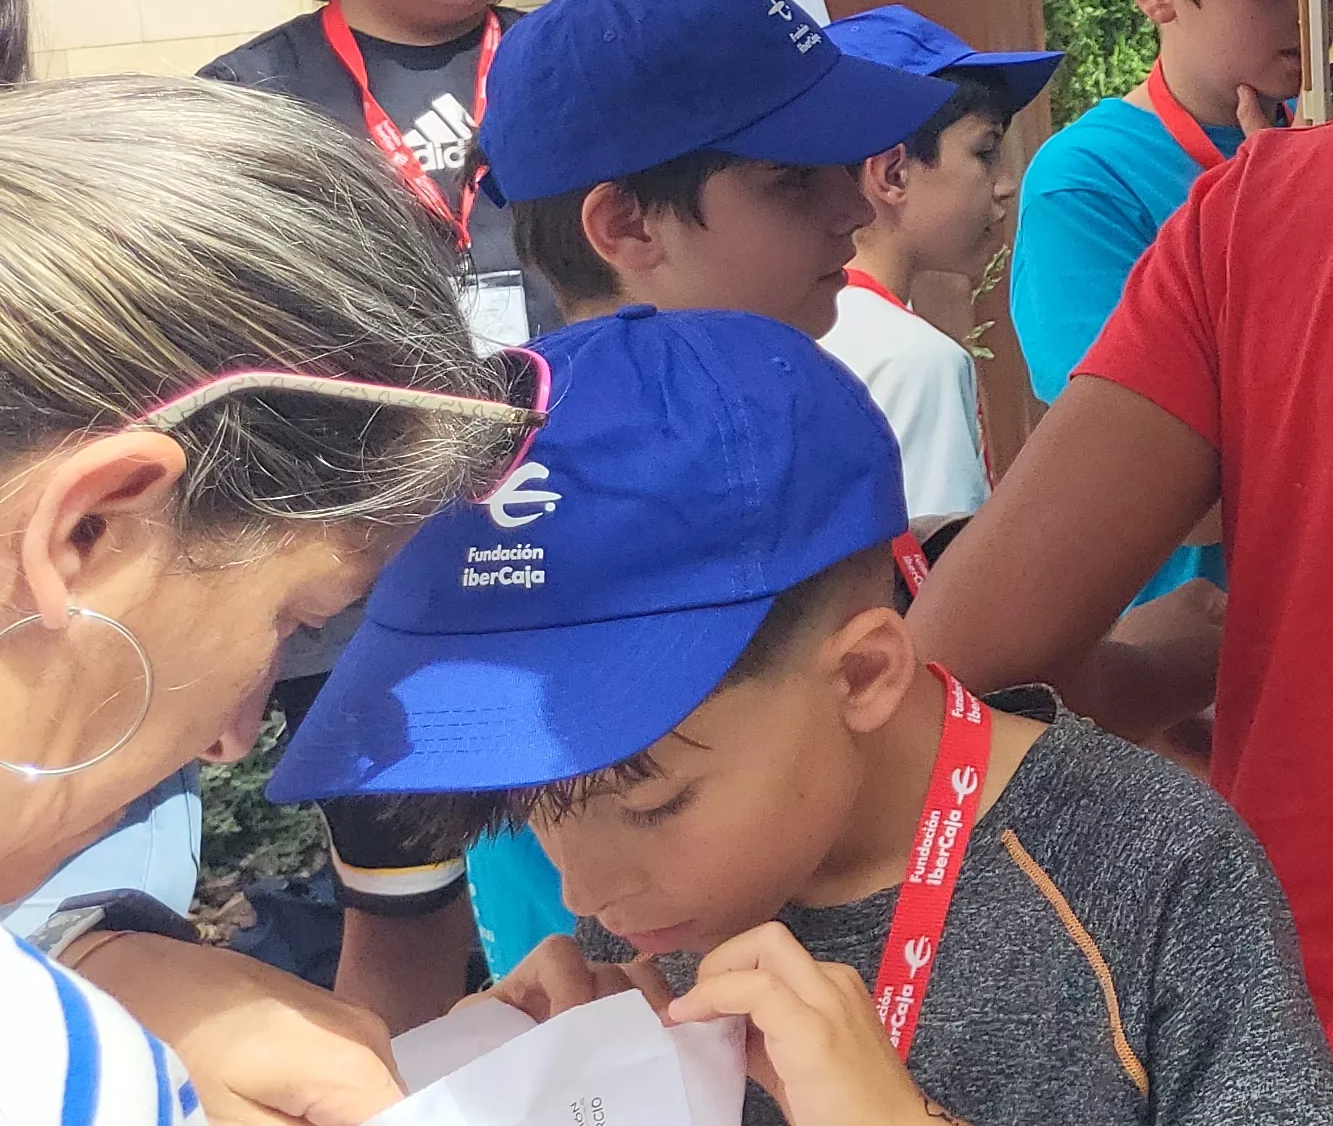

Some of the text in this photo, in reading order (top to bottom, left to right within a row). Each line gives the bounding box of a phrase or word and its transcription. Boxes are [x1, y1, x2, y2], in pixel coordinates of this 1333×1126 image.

[462, 565, 545, 589] iberCaja
[468, 543, 544, 563] Fundación
[910, 809, 942, 884] Fundación
[926, 809, 963, 886] iberCaja
